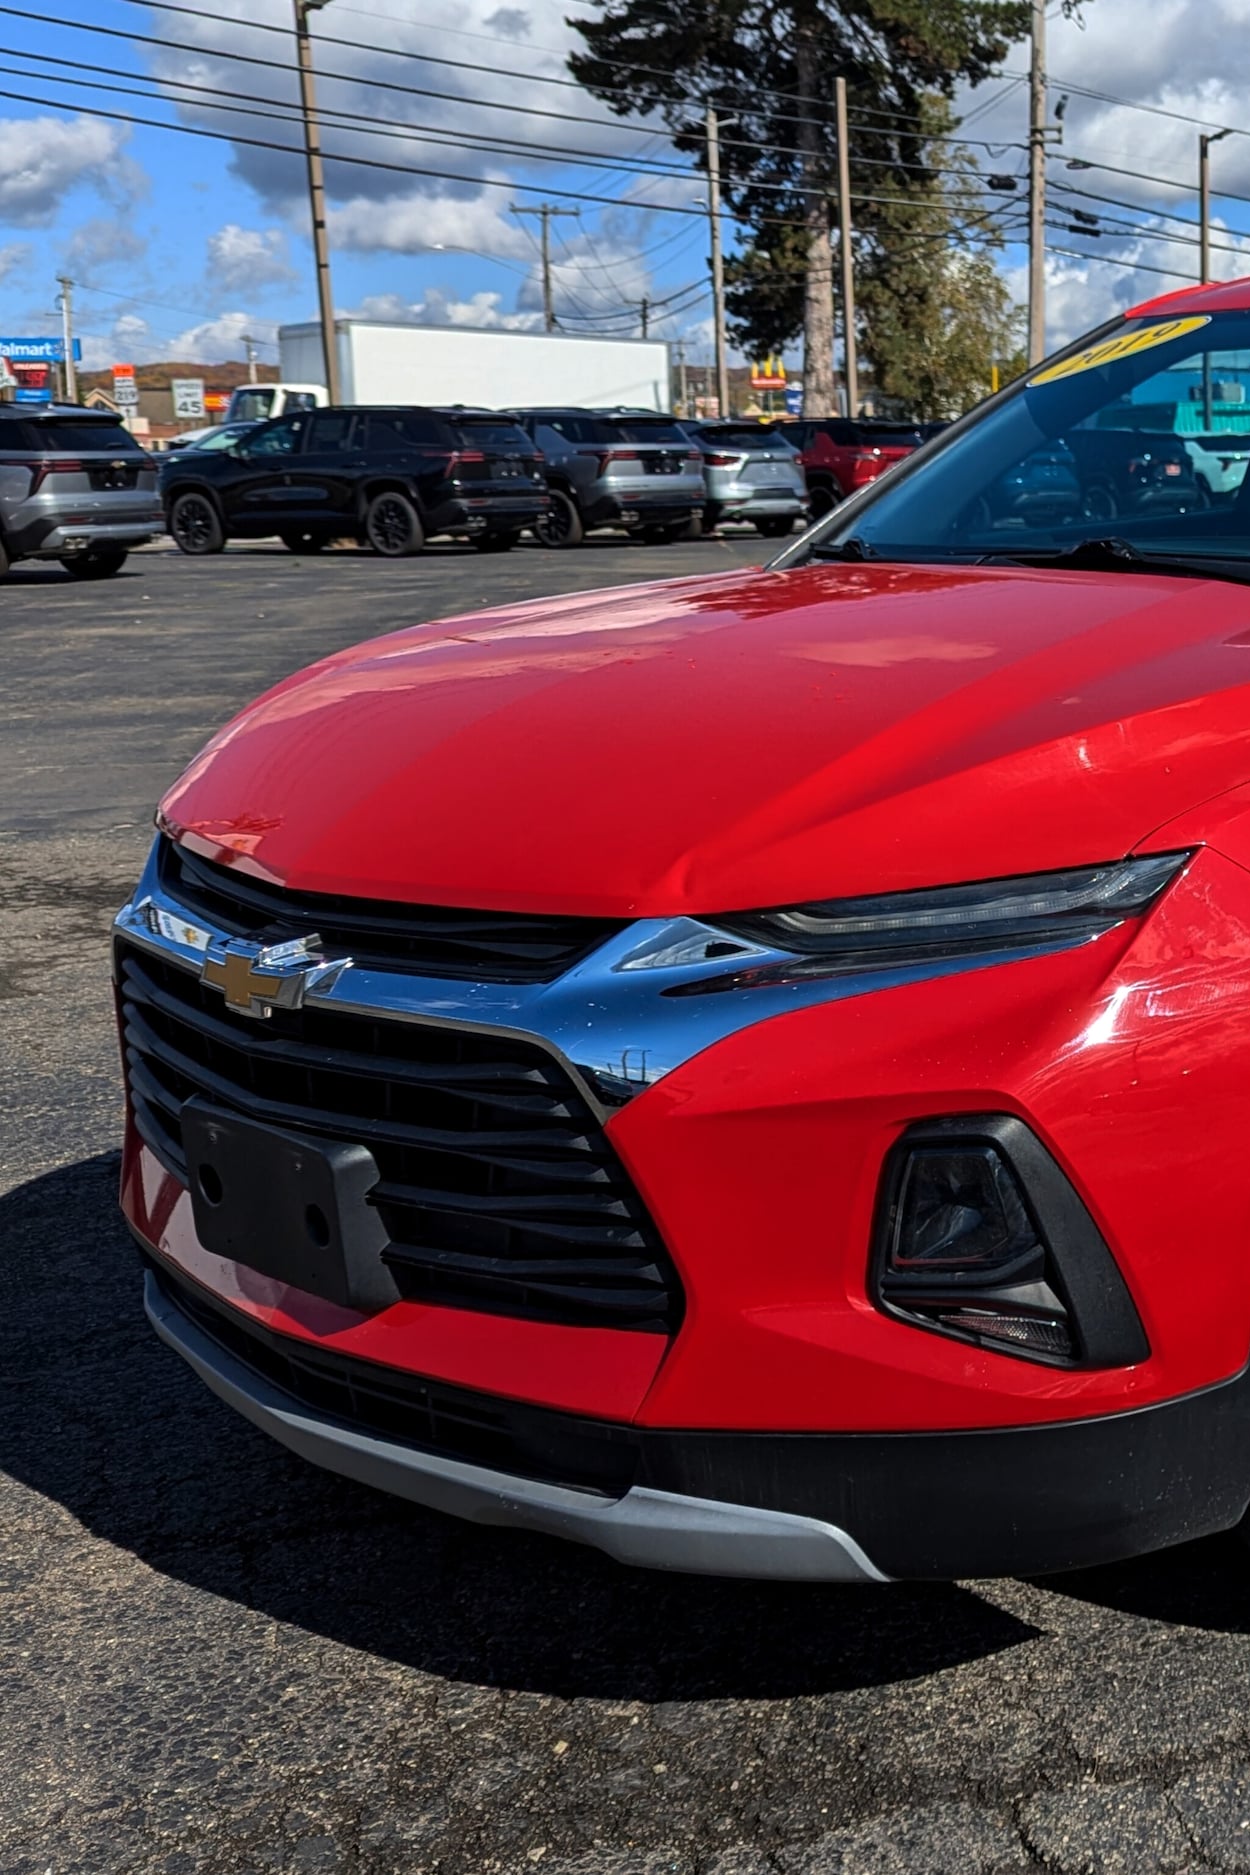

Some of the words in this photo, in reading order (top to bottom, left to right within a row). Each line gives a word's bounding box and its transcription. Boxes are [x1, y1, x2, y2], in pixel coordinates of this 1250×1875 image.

[0, 342, 54, 356] almart
[1052, 322, 1182, 378] 2019
[178, 401, 201, 413] 45
